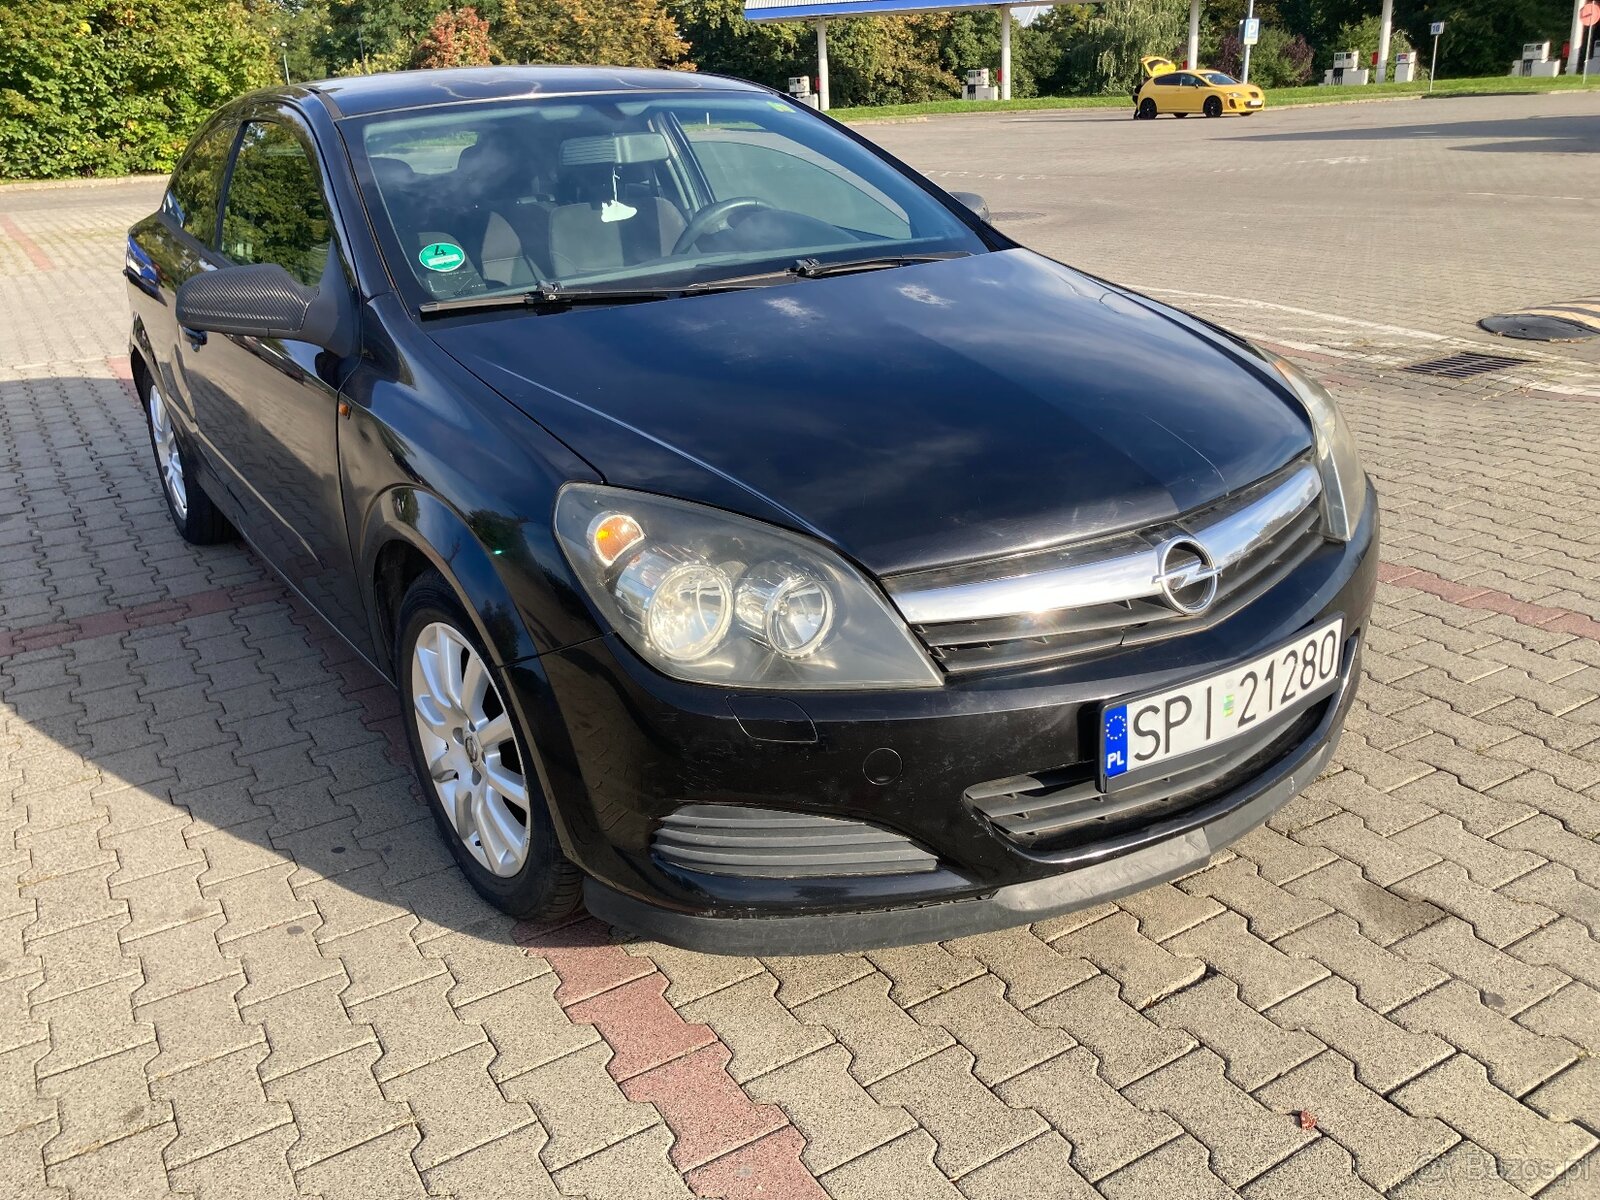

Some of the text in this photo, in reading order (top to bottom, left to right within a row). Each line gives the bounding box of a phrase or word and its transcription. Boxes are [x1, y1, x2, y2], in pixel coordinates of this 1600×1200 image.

[434, 245, 447, 256] 4
[1237, 629, 1337, 729] 21280
[1107, 750, 1125, 769] PL
